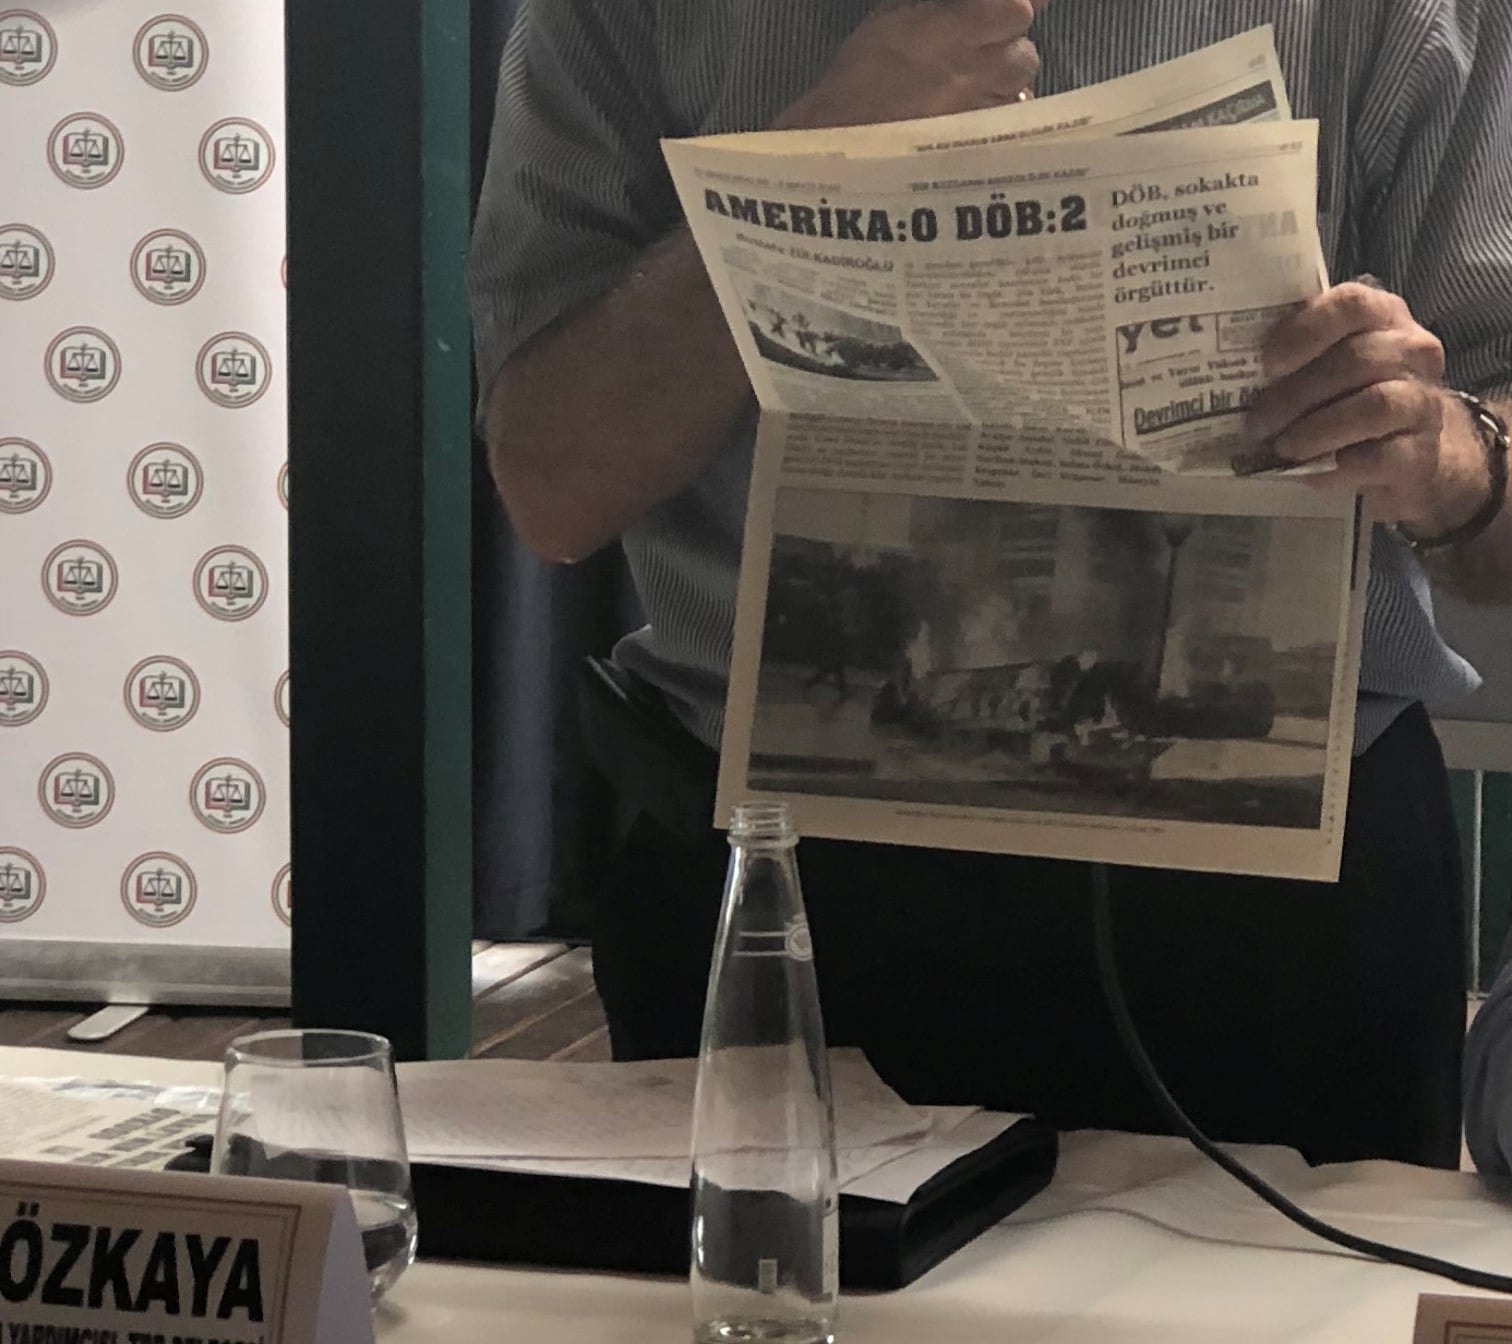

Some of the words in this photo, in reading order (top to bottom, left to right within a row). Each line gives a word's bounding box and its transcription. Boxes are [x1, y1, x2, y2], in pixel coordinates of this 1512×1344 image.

[1174, 173, 1259, 197] sokakta
[956, 192, 1087, 241] DÖB:2
[1112, 205, 1198, 232] doğmuş
[1203, 201, 1227, 216] ve
[1111, 226, 1202, 259] gelişmiş
[1207, 221, 1240, 241] bir
[1112, 250, 1210, 279] devrimci
[1114, 277, 1215, 304] örgüttür.
[1134, 392, 1204, 429] Devrimci
[1210, 389, 1233, 411] bir
[0, 1202, 264, 1322] ÖZKAYA
